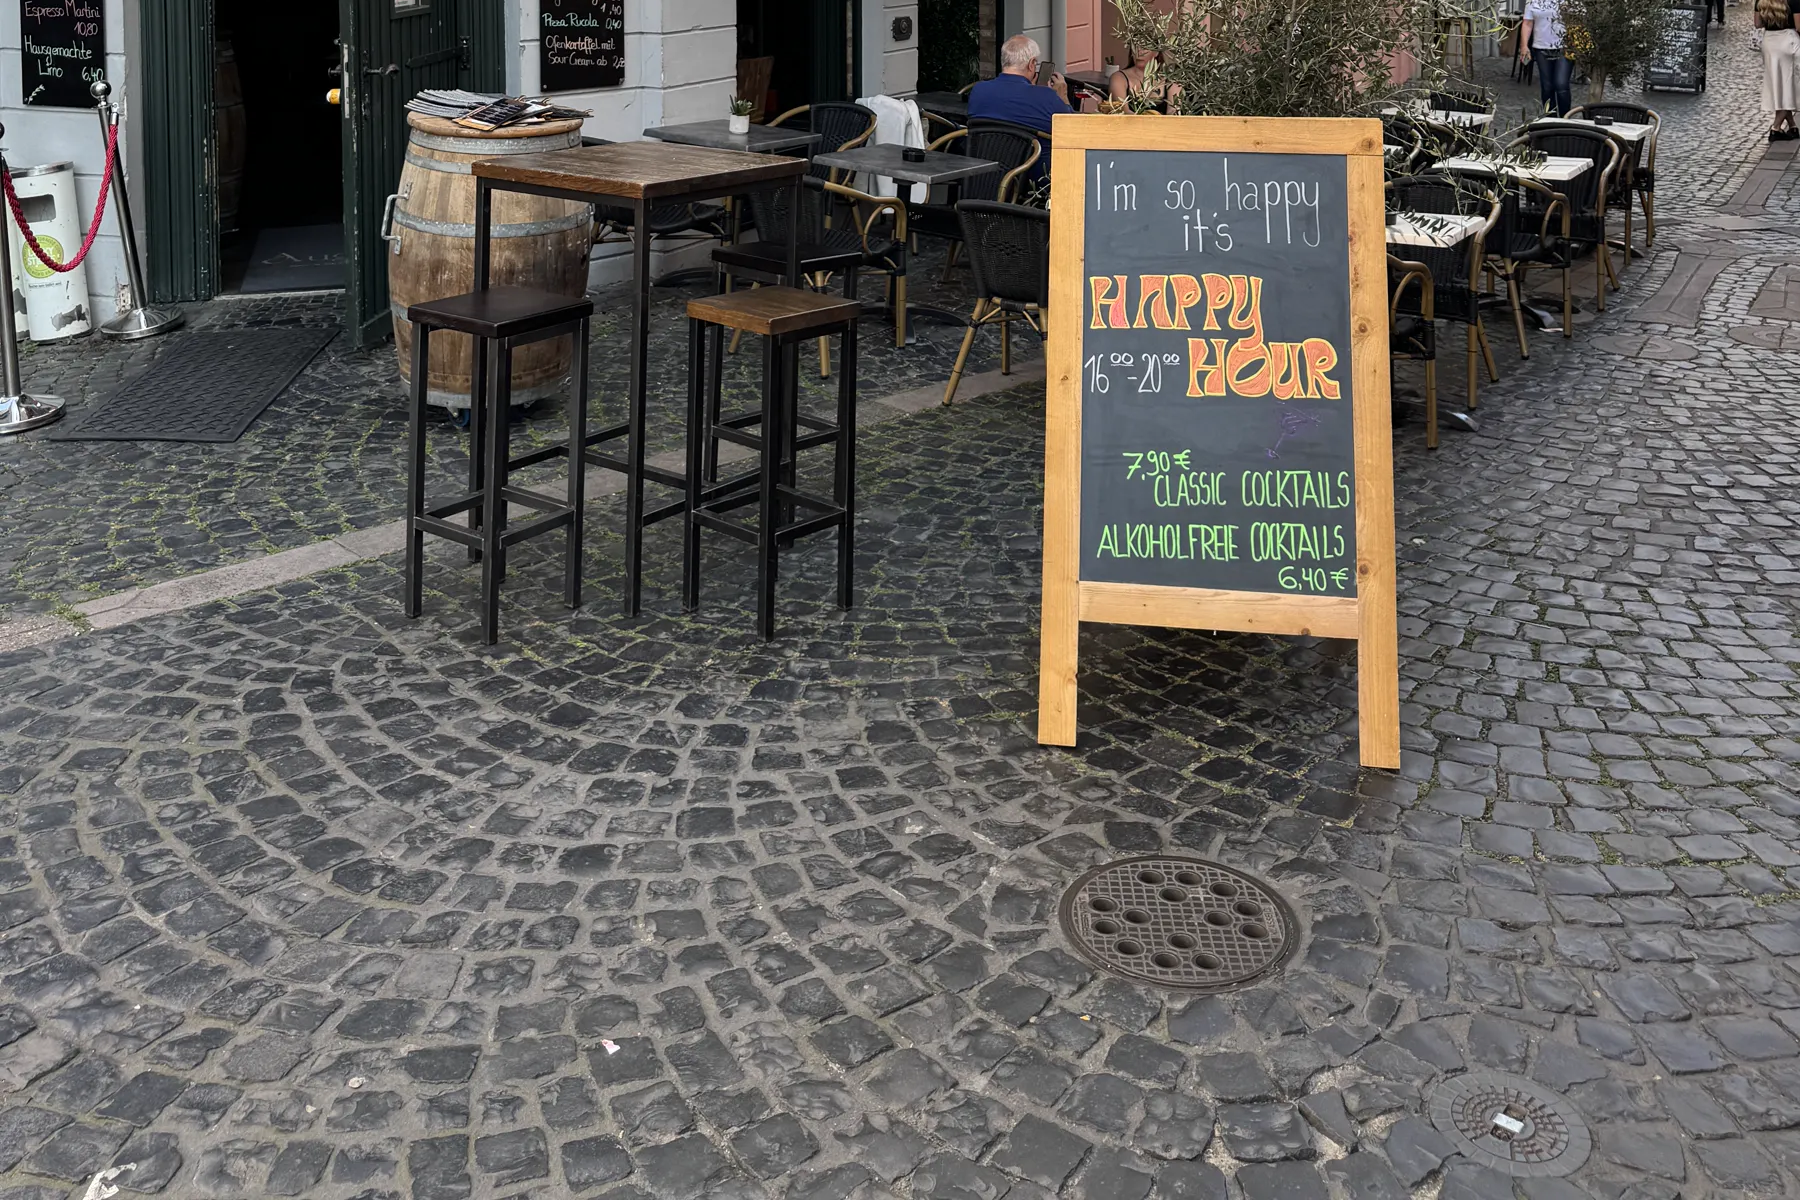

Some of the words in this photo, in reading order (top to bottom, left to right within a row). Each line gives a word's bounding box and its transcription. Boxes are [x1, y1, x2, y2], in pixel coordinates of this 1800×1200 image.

[24, 0, 65, 25] Espresso
[64, 0, 101, 18] Martini
[541, 12, 568, 27] Pizza
[565, 12, 600, 28] Rucola
[73, 21, 99, 37] 10,80
[545, 34, 601, 55] Ofenkartoffel
[600, 37, 616, 51] mit
[24, 34, 93, 66] Hausgemachte
[548, 50, 568, 65] Sour
[568, 51, 595, 67] Cream
[596, 55, 608, 67] ab
[37, 58, 64, 78] Limo
[81, 66, 104, 81] 6,40
[1096, 161, 1137, 211] I'm
[1164, 180, 1195, 210] so
[1224, 157, 1321, 247] happy
[1182, 209, 1233, 252] it's
[1089, 273, 1263, 350] HAPPY
[1186, 338, 1341, 400] HOUR
[1154, 471, 1227, 508] CLASSIC
[1241, 470, 1350, 509] COCKTAILS
[1249, 522, 1346, 561] COCKTAILS
